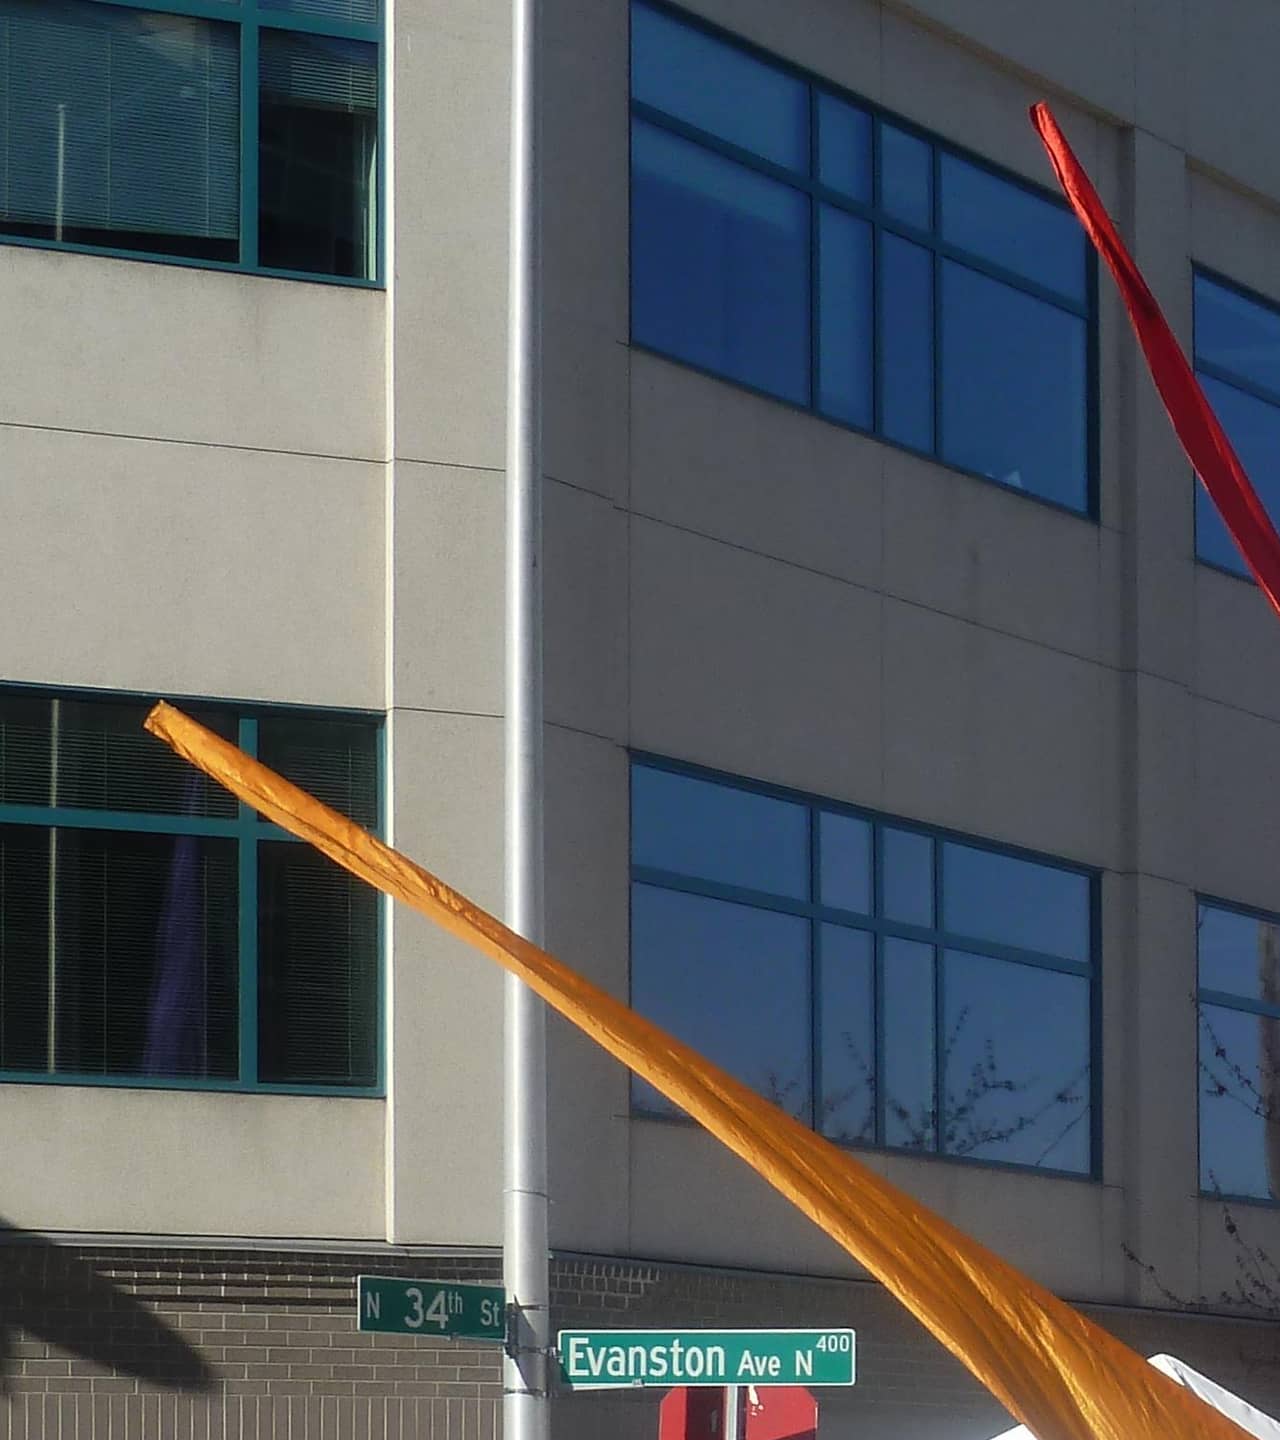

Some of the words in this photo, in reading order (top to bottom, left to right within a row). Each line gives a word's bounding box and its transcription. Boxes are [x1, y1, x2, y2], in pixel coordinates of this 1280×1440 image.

[366, 1291, 380, 1319] N
[404, 1287, 463, 1329] 34th
[480, 1299, 500, 1327] St
[568, 1337, 725, 1377] Evanston
[737, 1349, 781, 1376] Ave
[795, 1350, 813, 1376] N
[816, 1335, 849, 1352] 400
